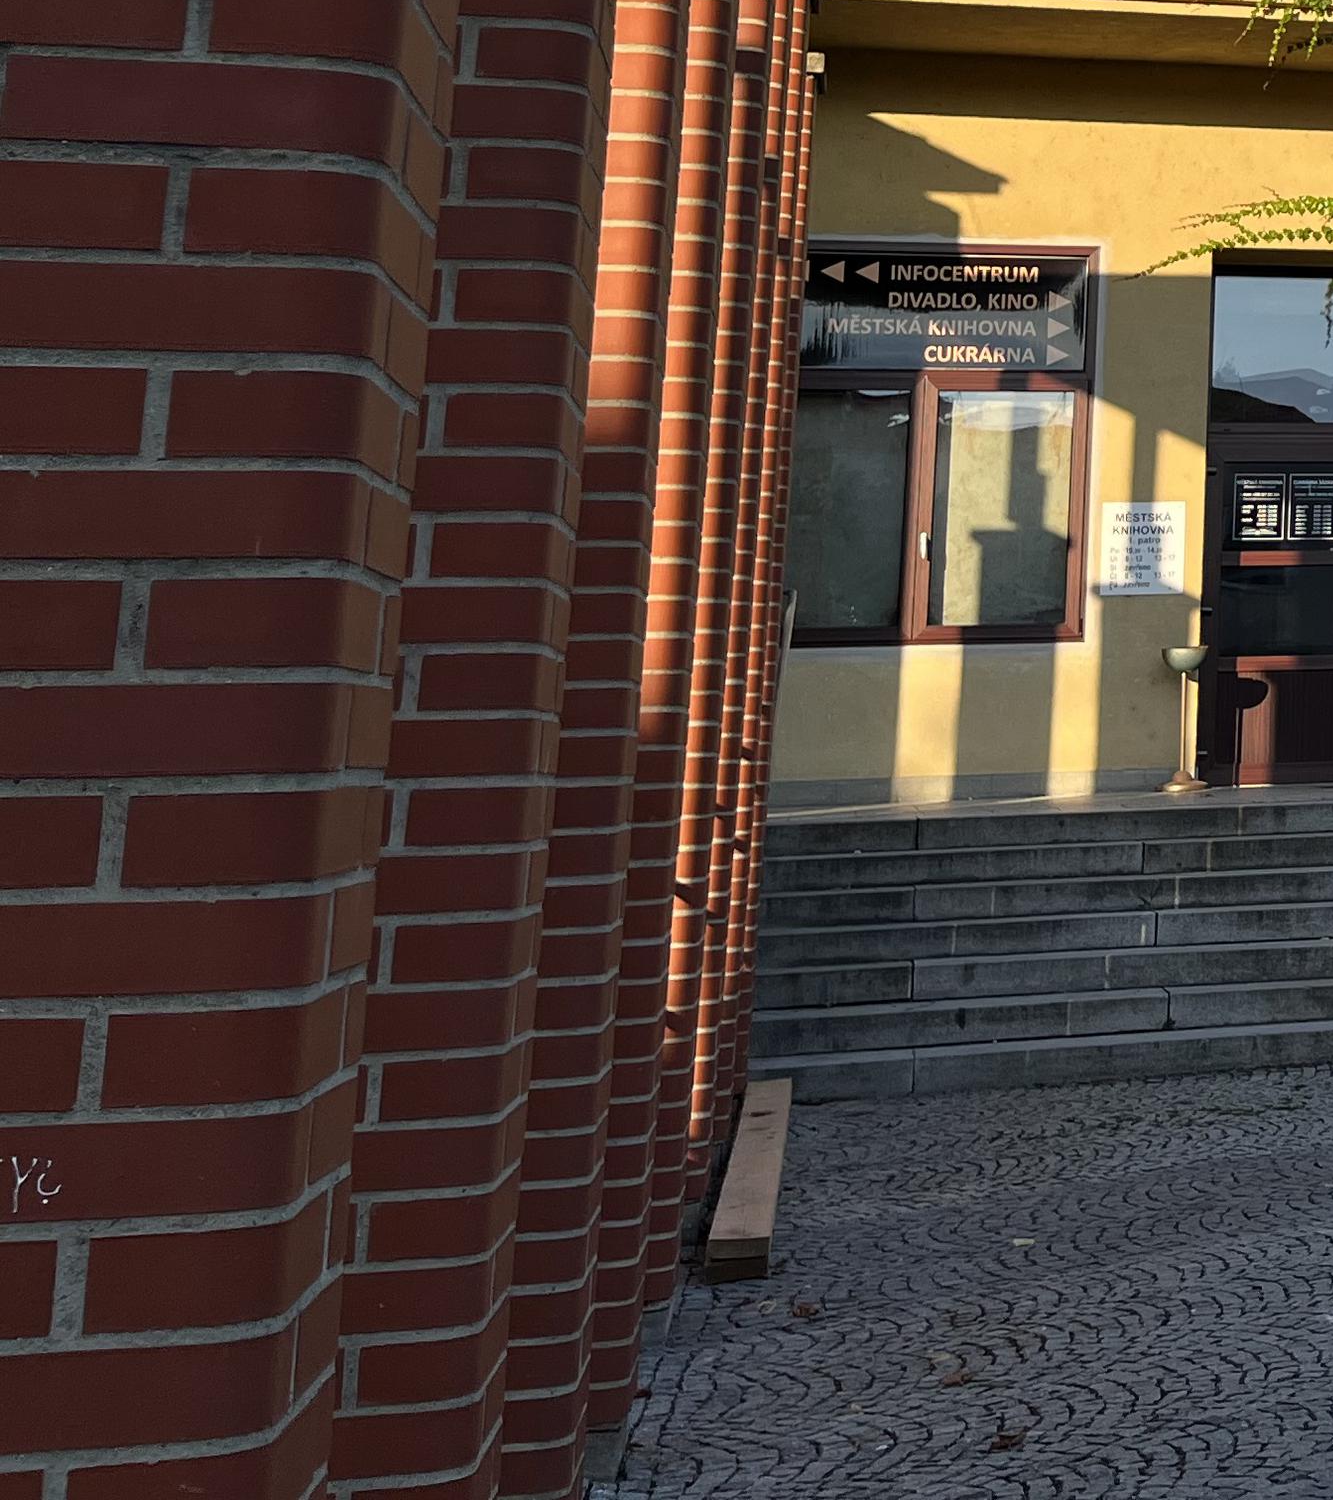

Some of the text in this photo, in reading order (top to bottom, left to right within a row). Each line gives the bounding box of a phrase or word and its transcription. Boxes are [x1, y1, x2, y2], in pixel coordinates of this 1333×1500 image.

[890, 264, 1039, 284] INFOCENTRUM
[888, 292, 1038, 312] DIVADLO, KINO
[827, 315, 1037, 337] MĚSTSKÁ KNIHOVNA
[923, 342, 1036, 364] CUKRÁRNA
[1115, 511, 1172, 523] MĚSTSKÁ
[1112, 525, 1174, 535] KNIHOVNA
[1137, 536, 1161, 545] patro
